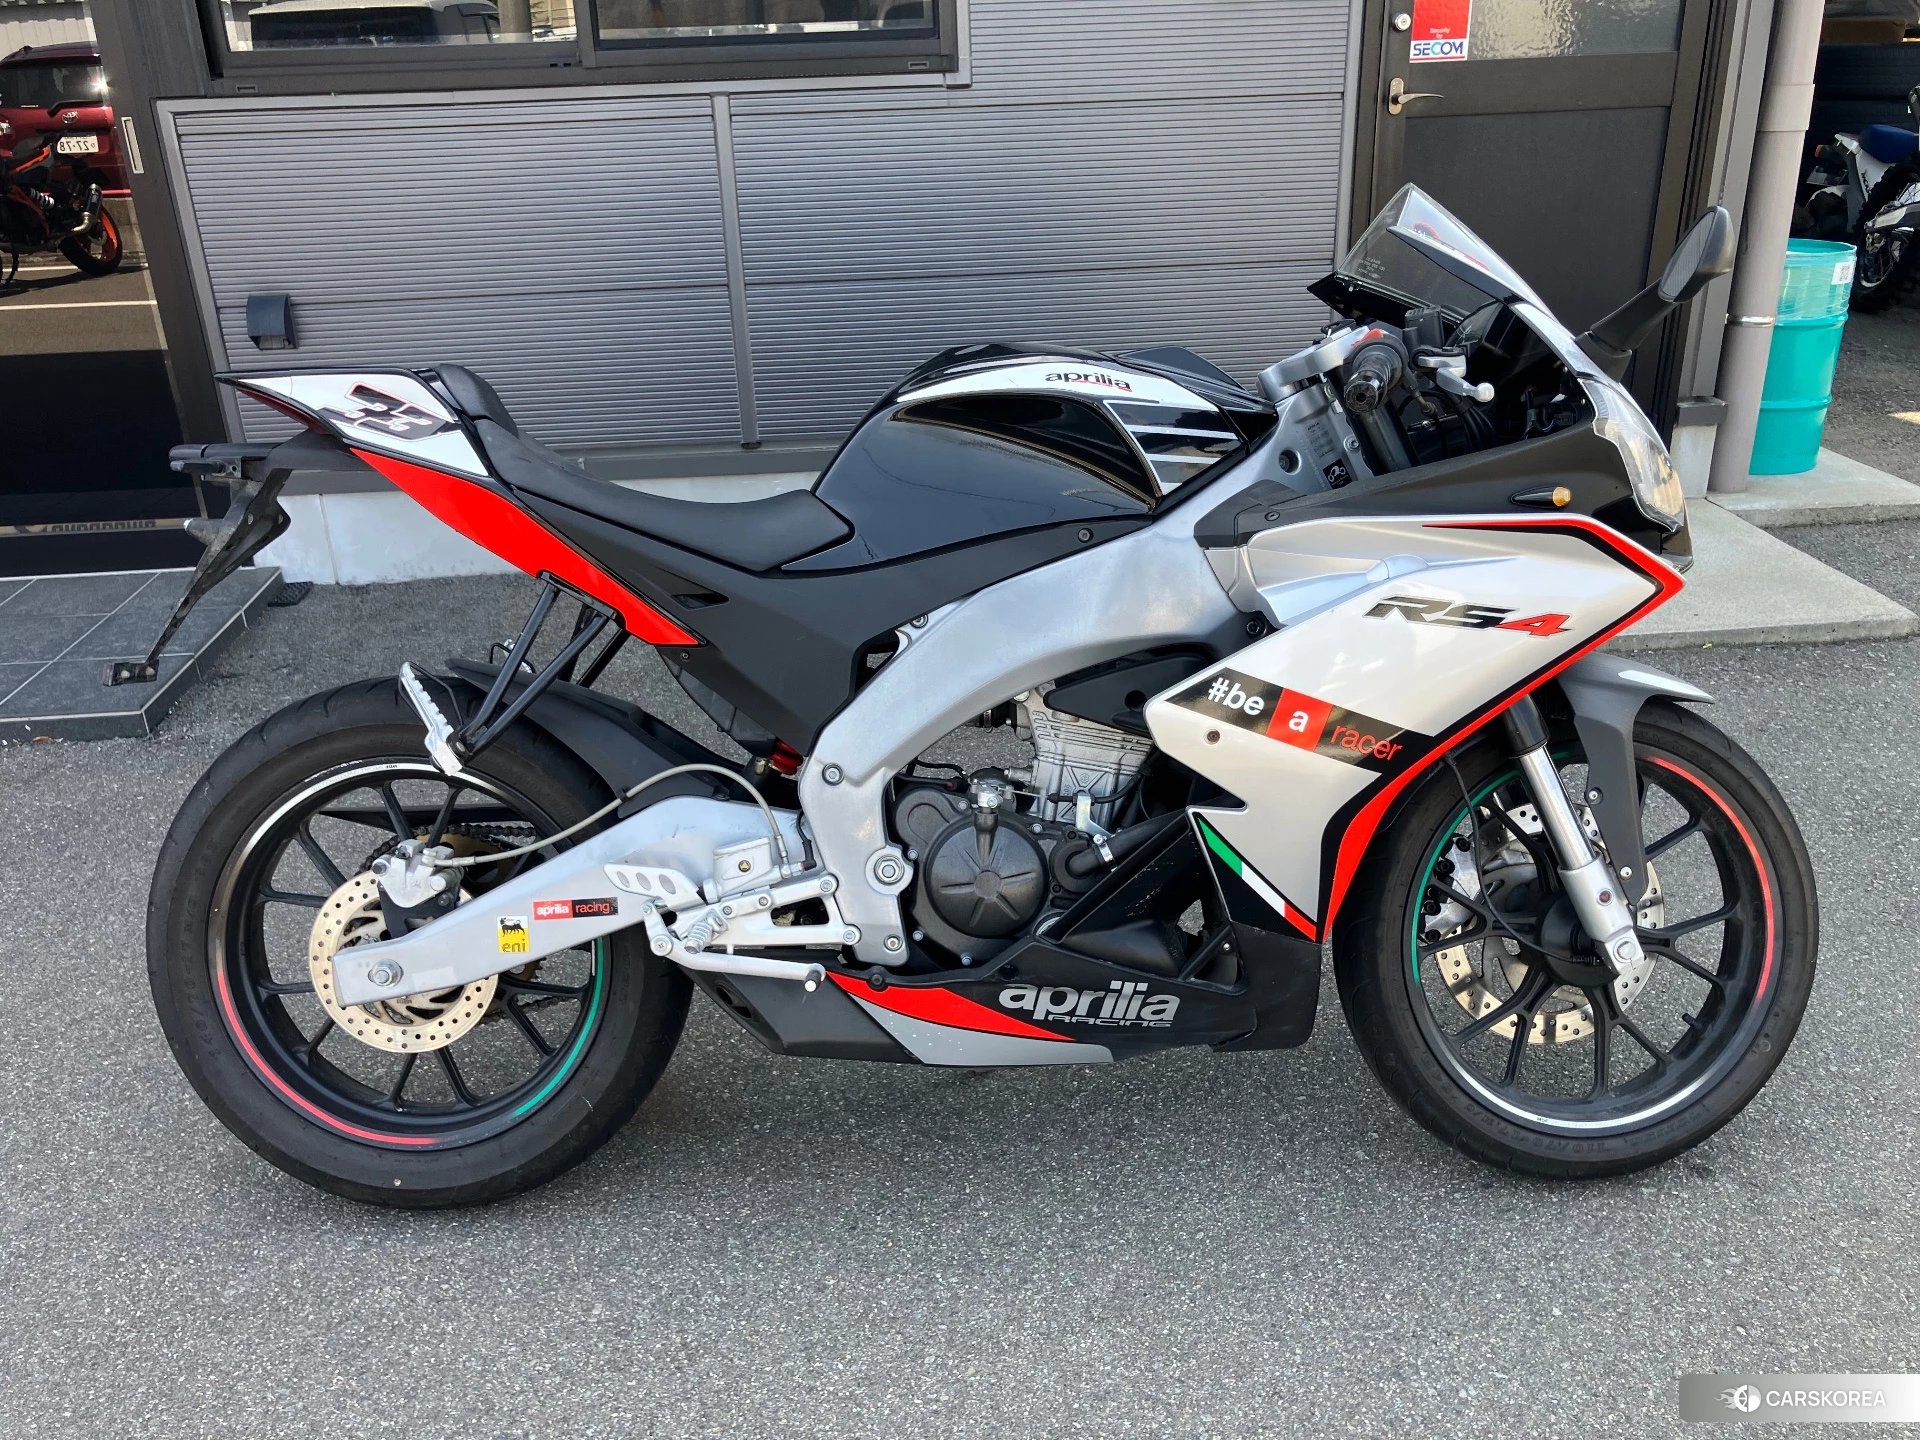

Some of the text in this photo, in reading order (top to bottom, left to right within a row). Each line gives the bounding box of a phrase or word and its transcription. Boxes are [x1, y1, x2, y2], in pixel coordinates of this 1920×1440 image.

[1413, 41, 1463, 56] SECOM
[1045, 372, 1132, 391] aprilia
[1362, 595, 1575, 639] RS4
[1207, 677, 1403, 761] #be a racer
[537, 902, 610, 917] aprilia racing
[502, 938, 526, 953] eni
[998, 980, 1181, 1021] aprilia
